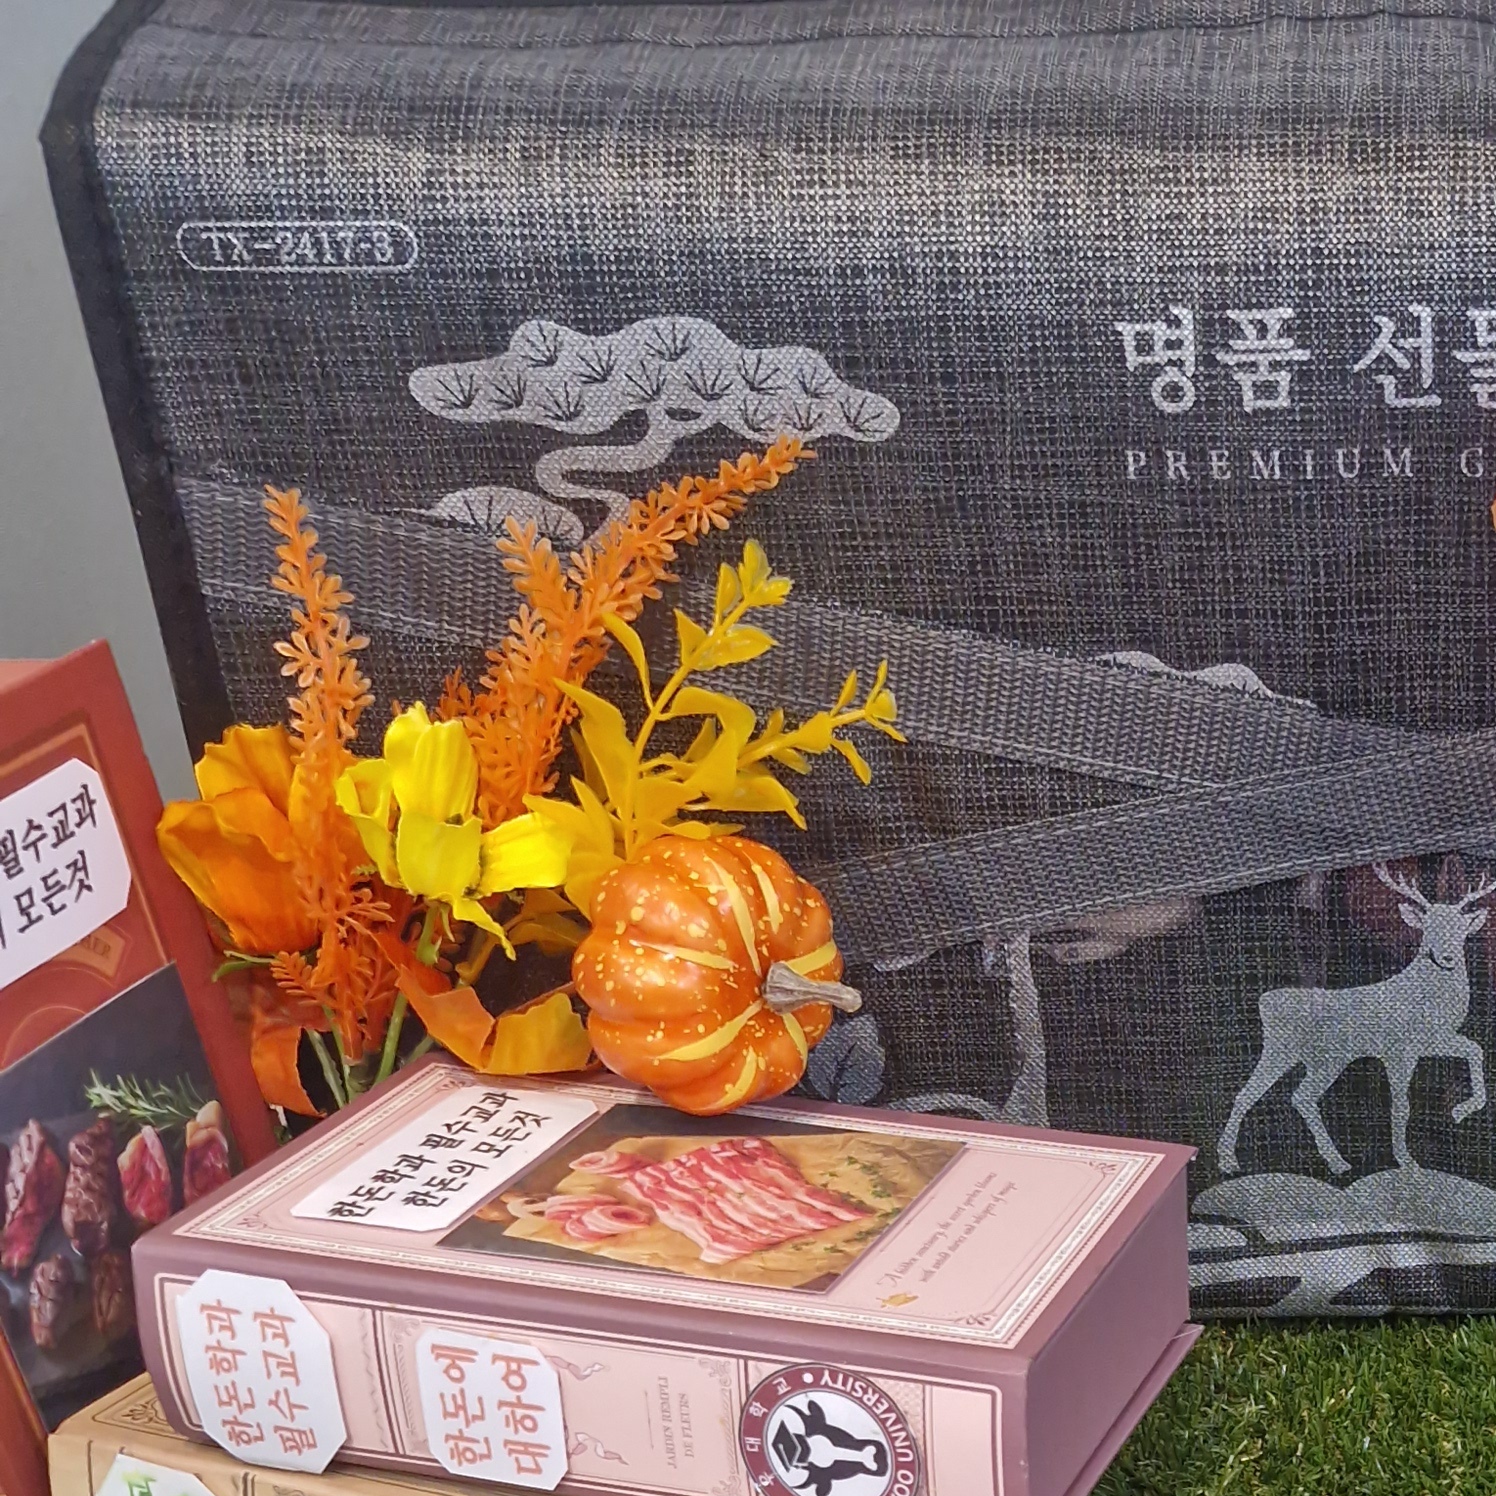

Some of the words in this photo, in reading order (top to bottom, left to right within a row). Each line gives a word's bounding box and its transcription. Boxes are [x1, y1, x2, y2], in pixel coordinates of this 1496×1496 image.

[1112, 303, 1311, 413] 명품
[1126, 448, 1415, 481] PREMIUM
[14, 849, 94, 934] 모든것
[327, 1153, 438, 1218] 한돈학과
[418, 1091, 520, 1150] 필수교과
[402, 1159, 490, 1208] 한돈의
[471, 1109, 554, 1160] 모든것
[200, 1299, 265, 1448] 한돈학과
[253, 1306, 318, 1457] 필수교과
[430, 1343, 493, 1468] 한돈에
[491, 1353, 552, 1476] 대하여
[819, 1368, 914, 1463] UNIVERSITY
